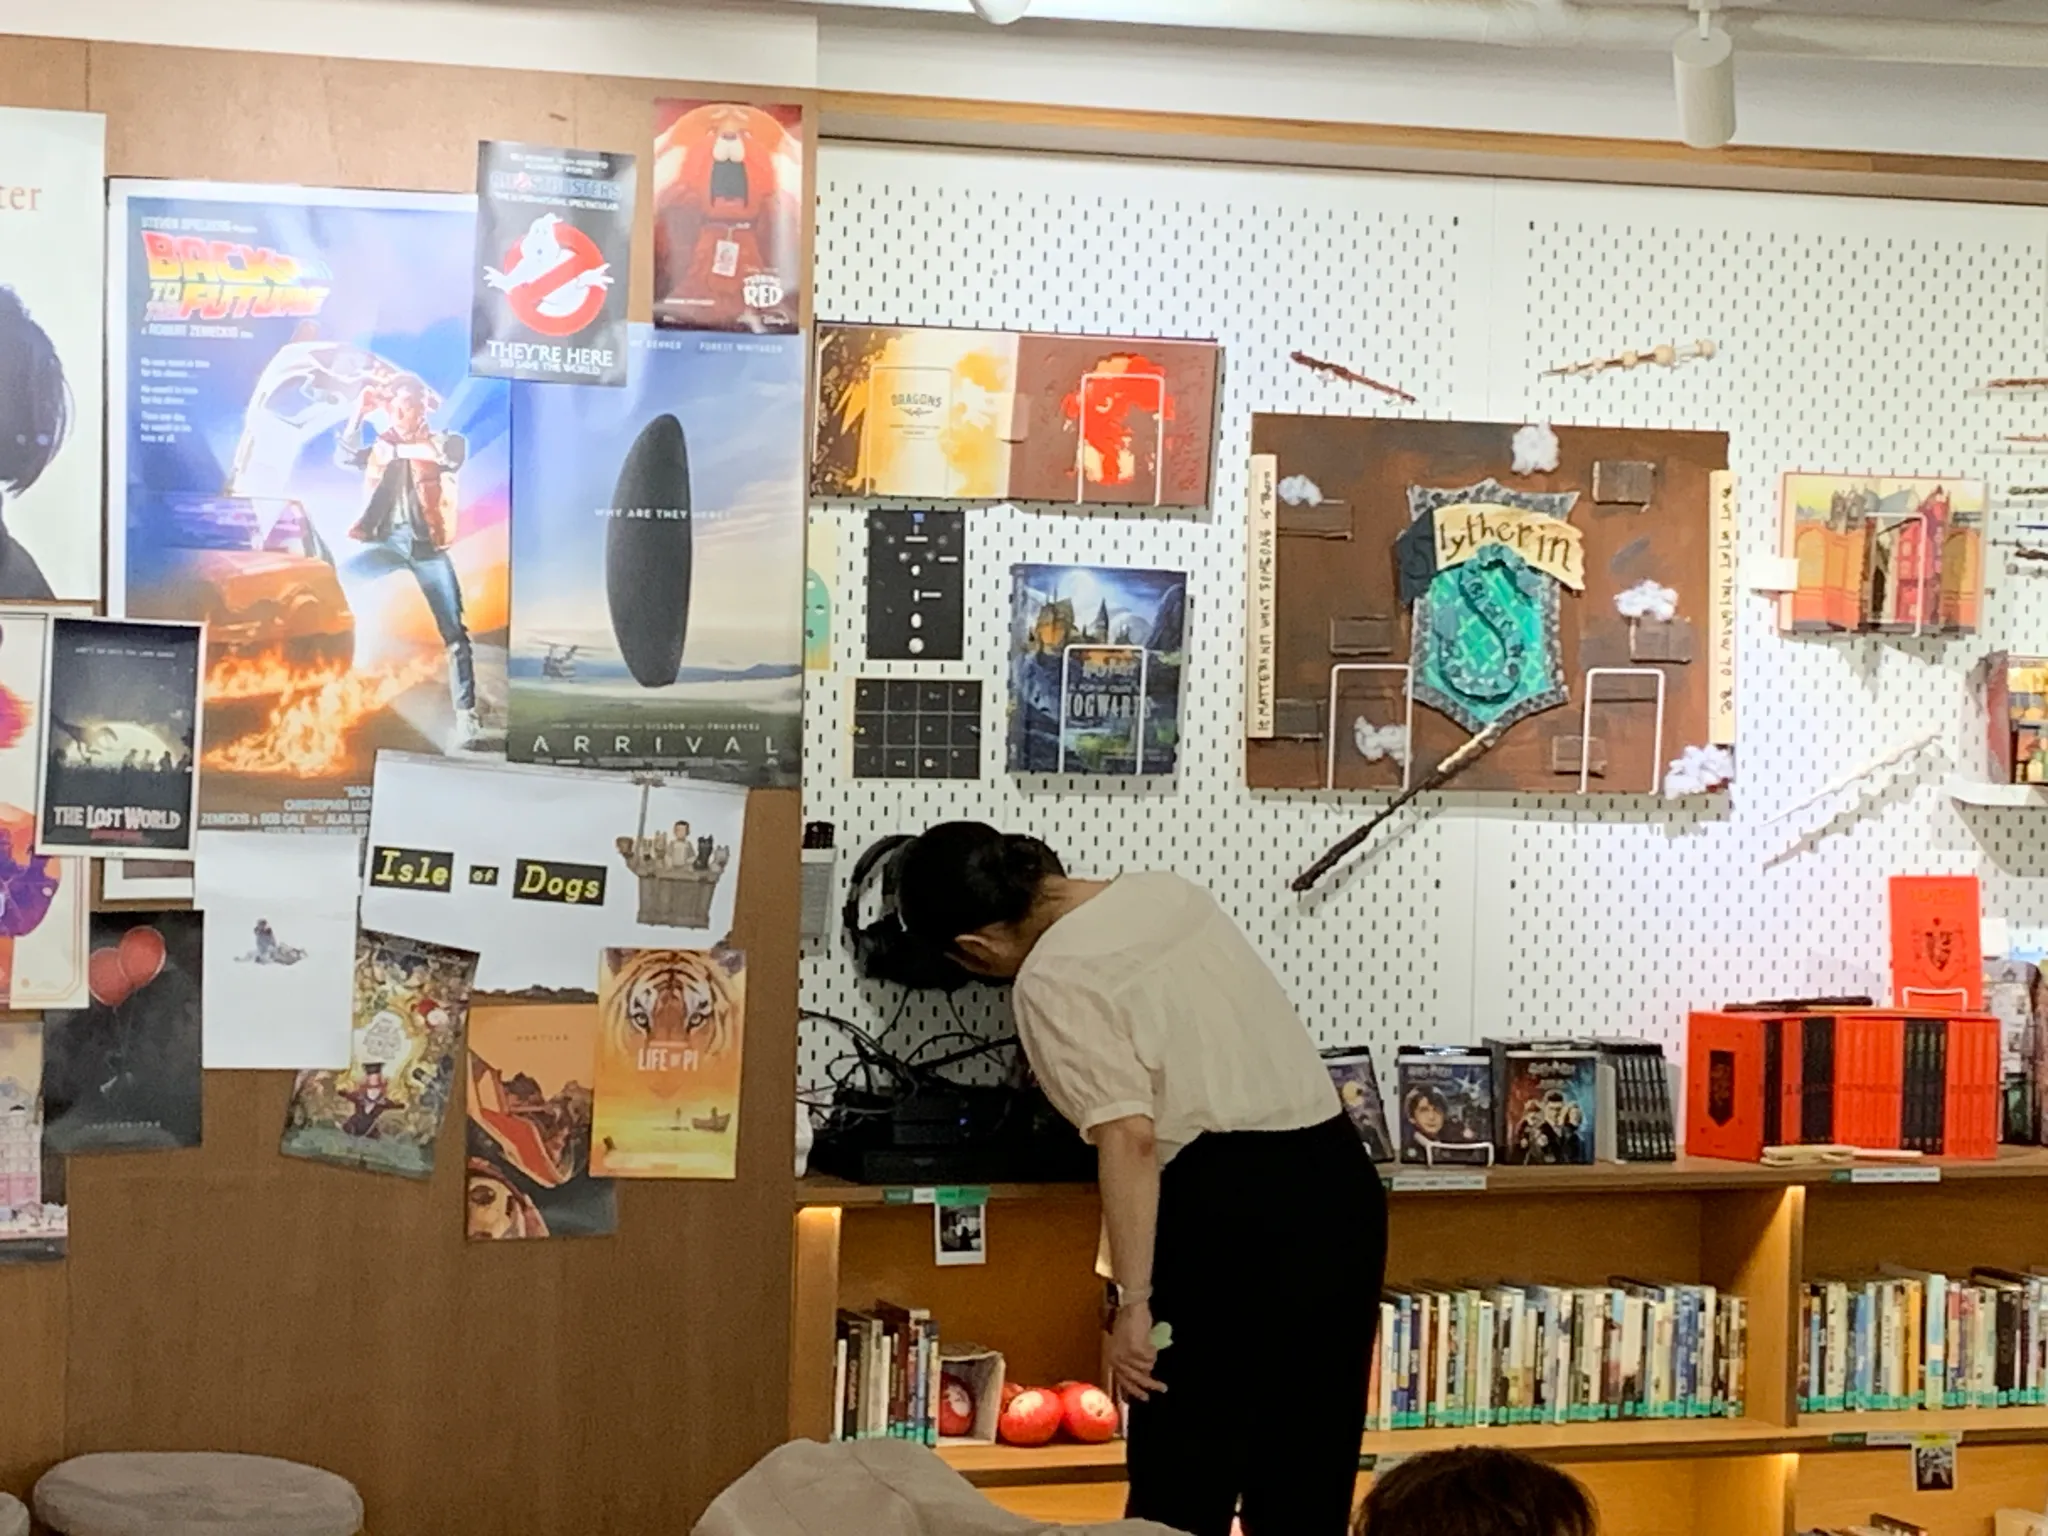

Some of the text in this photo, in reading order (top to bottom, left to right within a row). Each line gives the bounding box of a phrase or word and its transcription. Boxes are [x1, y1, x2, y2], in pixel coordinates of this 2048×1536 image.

[141, 230, 312, 284] BACK
[180, 284, 331, 320] FUTURE
[743, 284, 784, 308] RED
[486, 340, 614, 368] THEY'RE HERE
[891, 393, 942, 408] DRAGONS
[594, 508, 623, 518] WHY
[627, 508, 652, 519] ARE
[656, 508, 689, 519] THEY
[533, 735, 779, 755] ARRIVAL
[53, 804, 182, 830] THE LOST WORLD
[376, 850, 600, 904] Isle of Dogs
[638, 1048, 668, 1072] LIFE
[683, 1049, 699, 1072] PI
